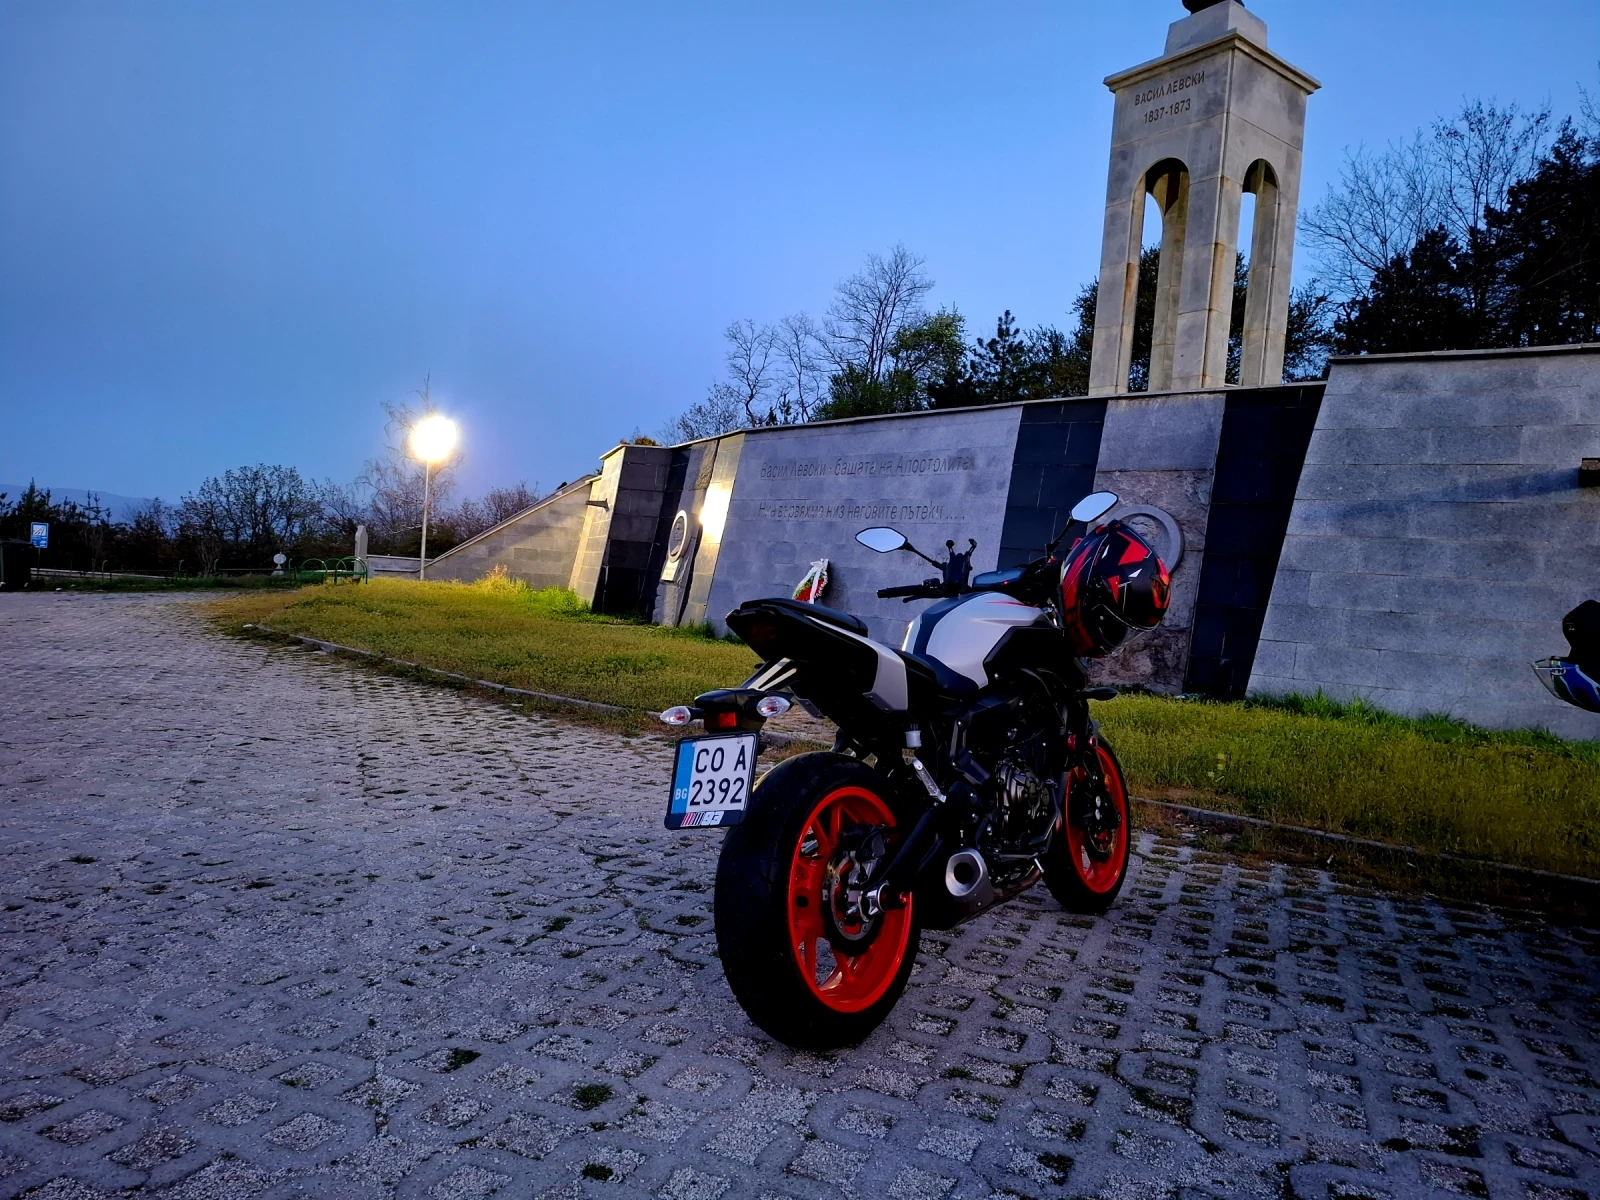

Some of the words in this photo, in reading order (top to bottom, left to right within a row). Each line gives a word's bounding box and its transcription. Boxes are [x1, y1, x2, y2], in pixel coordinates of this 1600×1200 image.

[1135, 86, 1164, 105] ВАСИЛ
[1166, 70, 1205, 95] ЛЕВСКИ
[1144, 98, 1191, 124] 1837-1873
[760, 462, 788, 478] Васил
[789, 460, 827, 477] Левски
[834, 458, 877, 477] бащата
[879, 460, 893, 474] на
[695, 747, 725, 774] CO
[733, 744, 747, 772] A
[674, 788, 688, 800] BG
[689, 777, 745, 806] 2392
